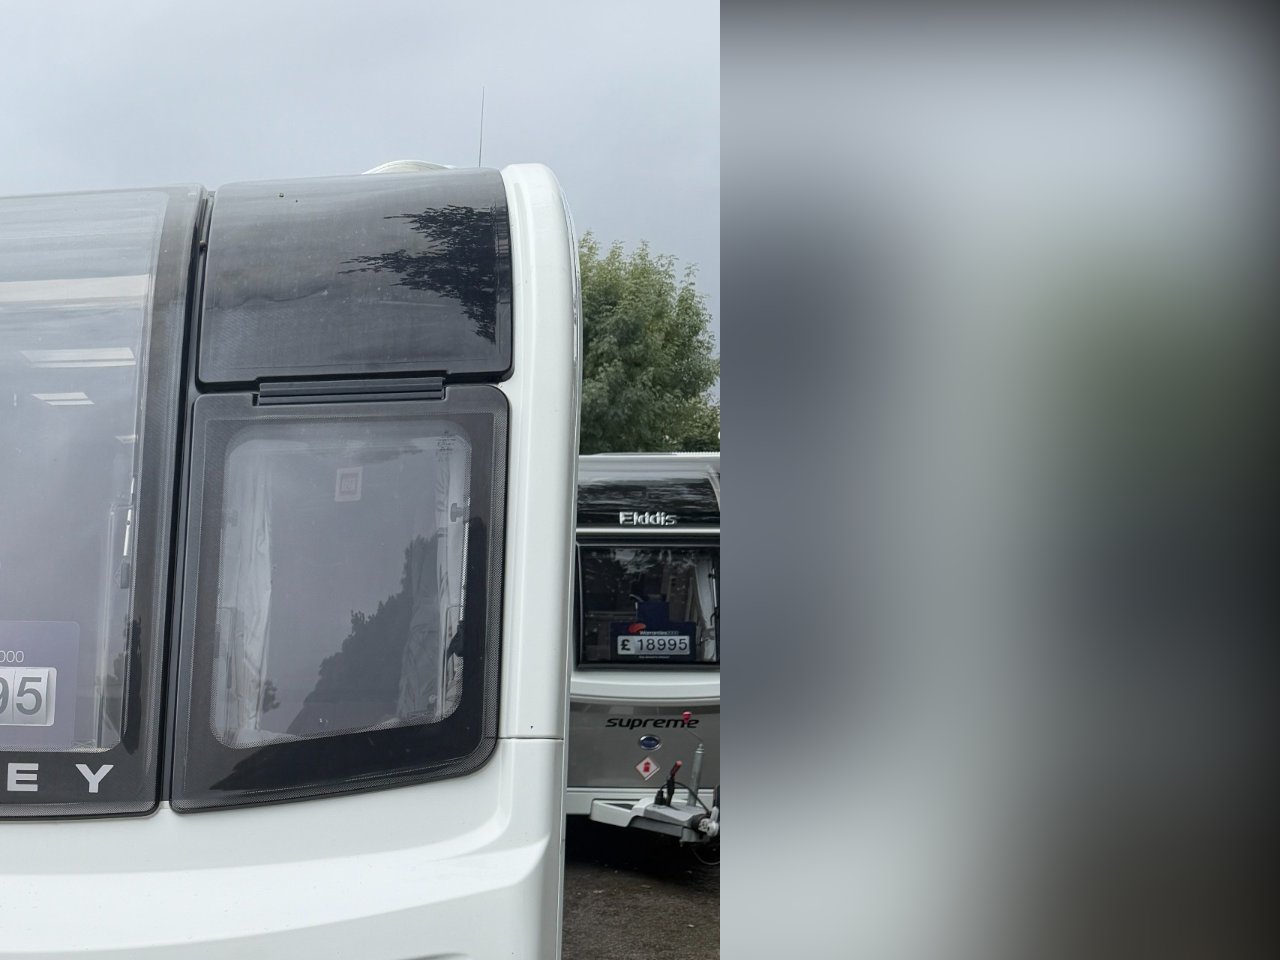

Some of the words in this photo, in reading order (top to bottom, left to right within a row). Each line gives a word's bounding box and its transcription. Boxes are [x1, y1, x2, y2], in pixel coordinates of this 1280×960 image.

[619, 511, 677, 526] Elddis
[637, 638, 688, 652] 18995
[605, 718, 700, 731] supreme
